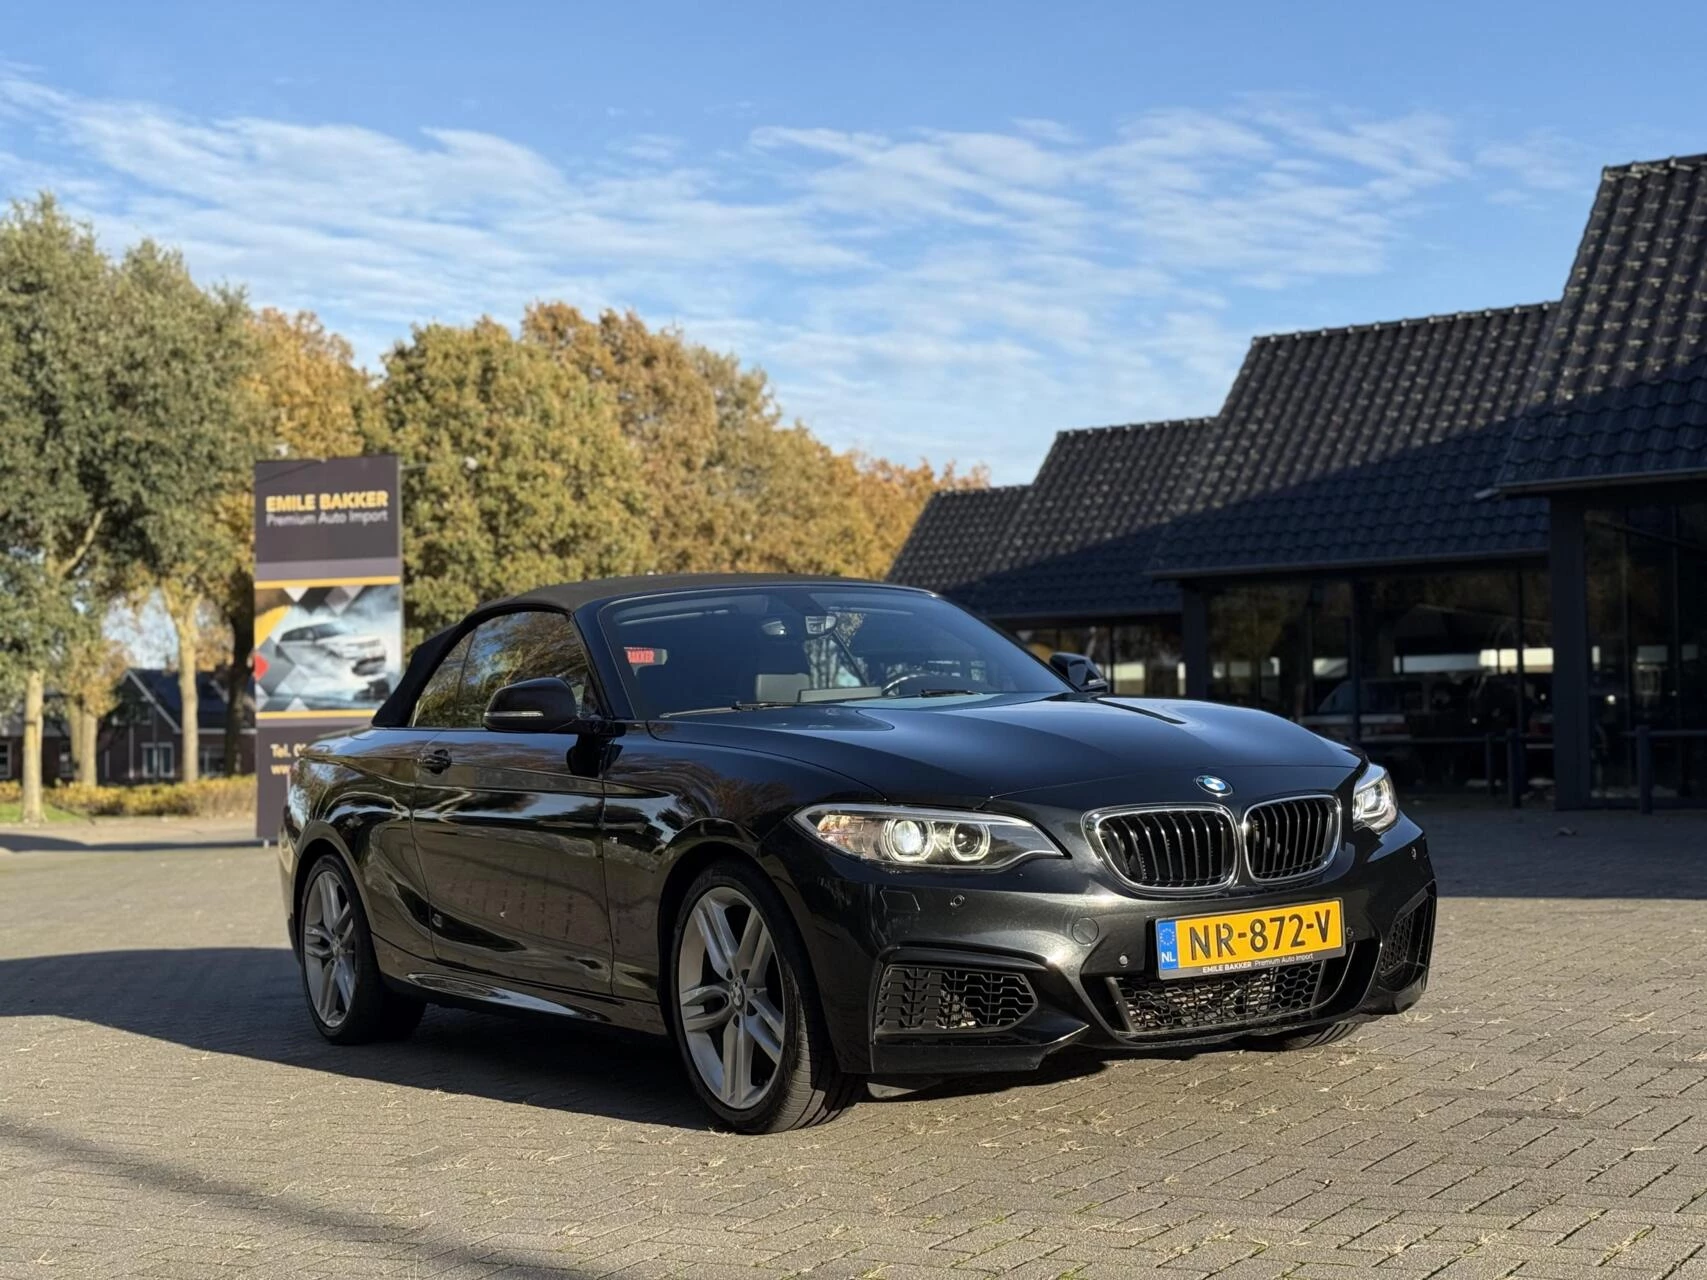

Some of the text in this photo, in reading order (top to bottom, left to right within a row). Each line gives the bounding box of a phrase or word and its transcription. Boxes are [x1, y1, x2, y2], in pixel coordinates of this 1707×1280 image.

[266, 490, 388, 512] EMILE BAKKER
[266, 510, 388, 526] Premium Auto Import
[270, 743, 291, 758] Tel.
[1189, 909, 1331, 961] NR-872-V
[1161, 951, 1177, 963] NL
[1202, 965, 1224, 974] EMILE
[1224, 961, 1252, 971] BAKKER
[1254, 958, 1280, 967] Premium
[1295, 953, 1314, 962] Import
